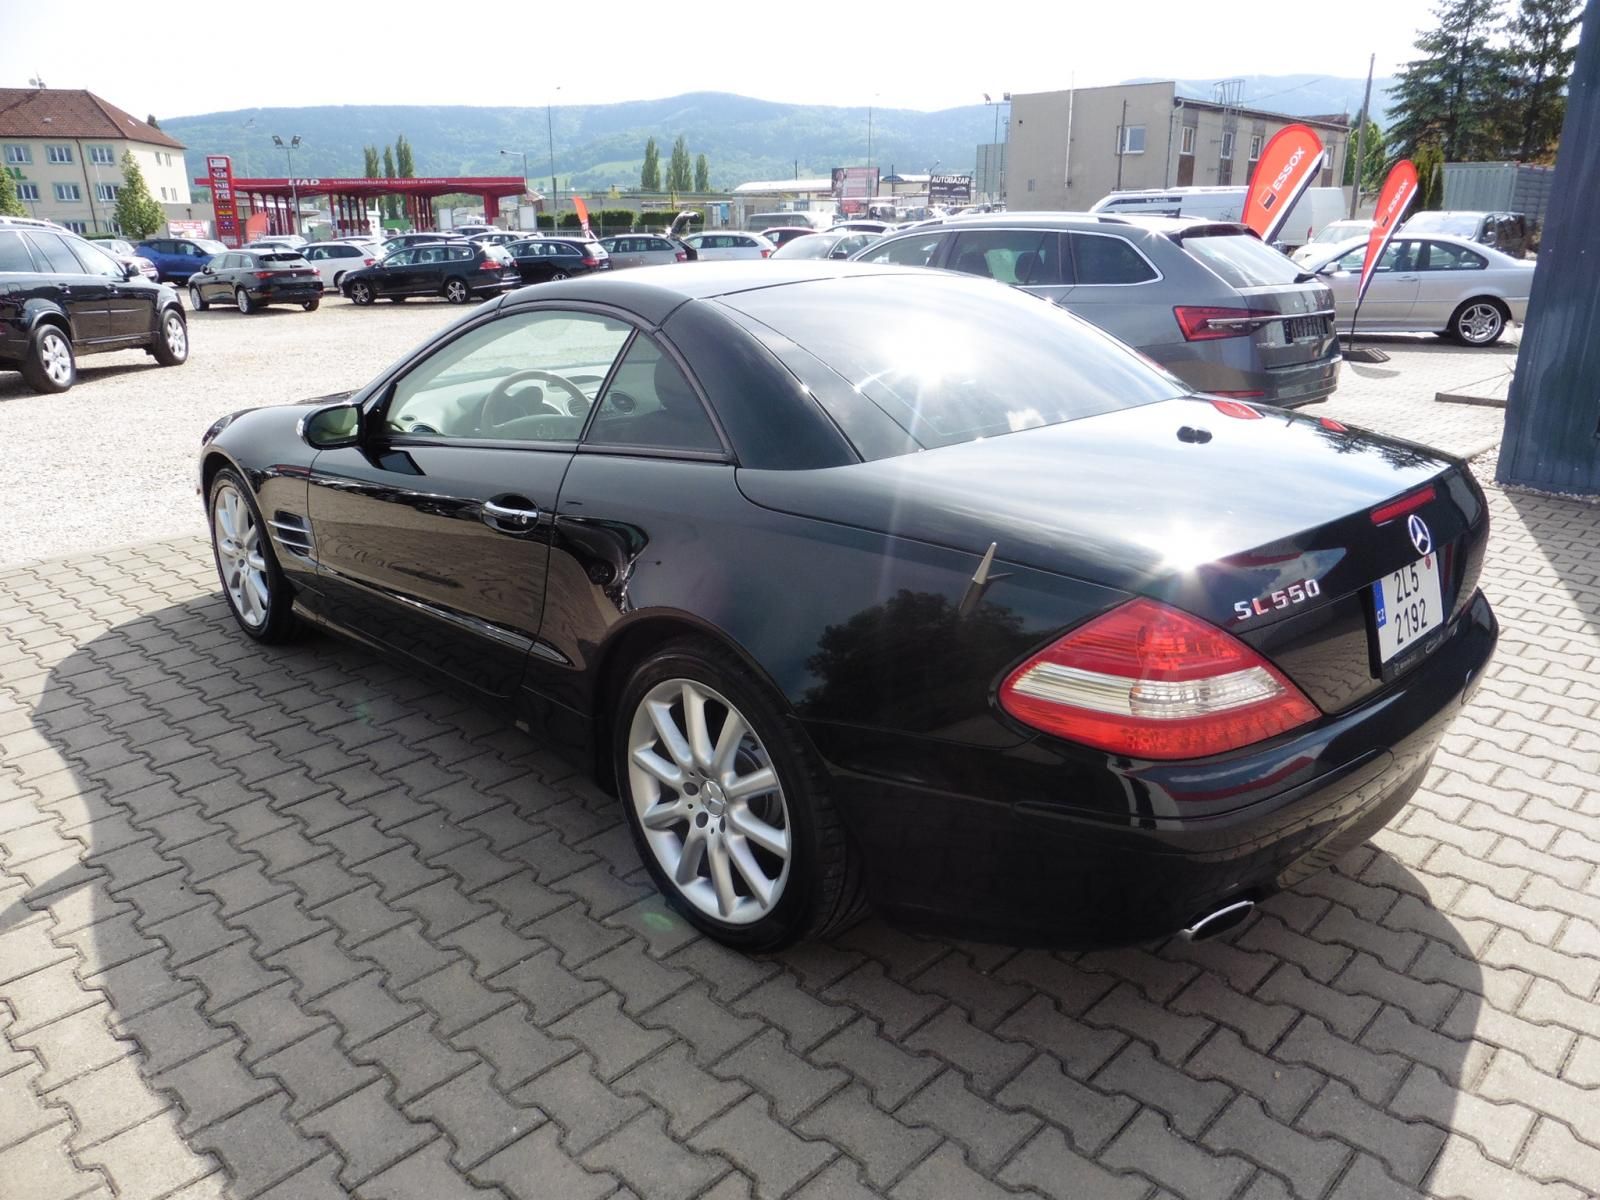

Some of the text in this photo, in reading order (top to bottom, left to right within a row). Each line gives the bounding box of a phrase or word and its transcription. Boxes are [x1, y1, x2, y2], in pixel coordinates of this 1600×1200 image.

[931, 176, 970, 185] AUTOBAZAR
[1272, 146, 1306, 191] ESSOX
[1387, 178, 1409, 213] ESSOX
[1394, 562, 1419, 603] 2L5
[1376, 607, 1385, 622] CZ
[1395, 598, 1427, 645] 2192
